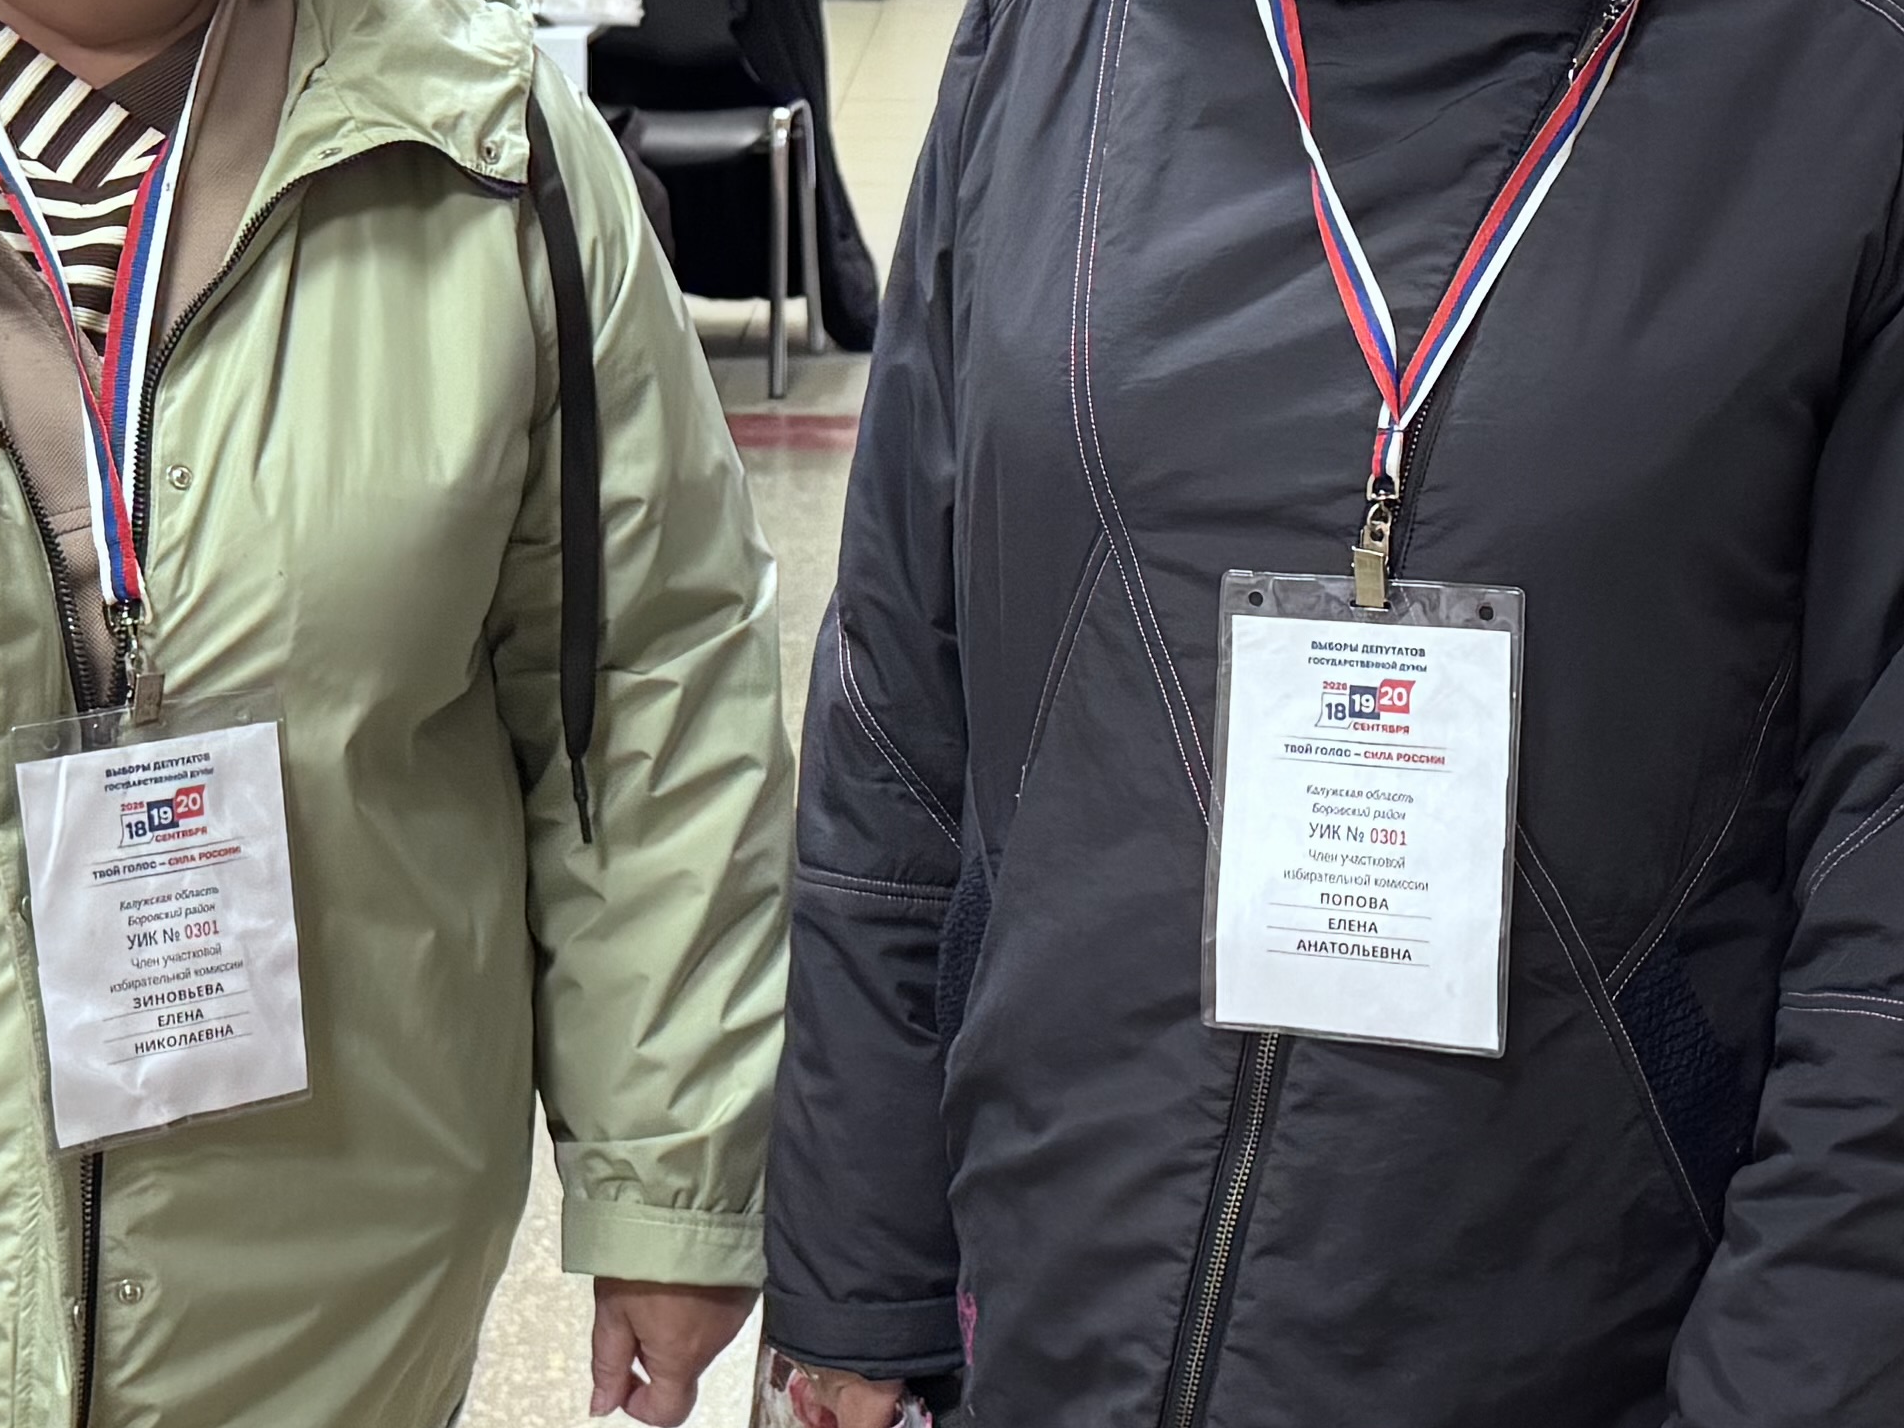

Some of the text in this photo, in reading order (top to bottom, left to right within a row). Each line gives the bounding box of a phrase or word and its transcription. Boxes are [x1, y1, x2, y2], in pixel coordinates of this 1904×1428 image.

[1311, 640, 1425, 657] ВЫБОРЫ ДЕПУТАТОВ
[1308, 656, 1397, 669] ГОСУДАРСТВЕННОЙ
[1351, 693, 1374, 713] 19
[1379, 686, 1407, 706] 20
[1325, 702, 1346, 721] 18
[1352, 721, 1409, 734] СЕНТЯБРЯ
[1284, 743, 1312, 754] ТВОЙ
[1314, 746, 1351, 757] ГОЛОС
[1363, 750, 1393, 760] СИЛА
[105, 752, 210, 778] ВЫБОРЫ ДЕПУТАТОВ
[176, 792, 201, 813] 20
[1306, 784, 1413, 803] Калужская область
[150, 806, 172, 826] 19
[1312, 802, 1405, 820] Боровский район
[125, 820, 147, 839] 18
[1309, 822, 1406, 846] УИК № 0301
[1308, 848, 1405, 868] Член участковой
[92, 865, 120, 880] ТВОЙ
[122, 860, 157, 874] ГОЛОС
[1283, 867, 1428, 891] избирательной комиссии
[119, 886, 219, 911] Калужская область
[1319, 891, 1389, 911] ПОПОВА
[127, 903, 215, 927] Боровский район
[127, 919, 219, 950] УИК № 0301
[1327, 917, 1379, 934] ЕЛЕНА
[130, 945, 221, 969] Член участковой
[1296, 938, 1413, 962] АНАТОЛЬЕВНА
[109, 960, 243, 993] избирательной комиссии
[132, 982, 225, 1010] ЗИНОВЬЕВА
[156, 1008, 205, 1027] ЕЛЕНА
[134, 1025, 234, 1055] НИКОЛАЕВНА
